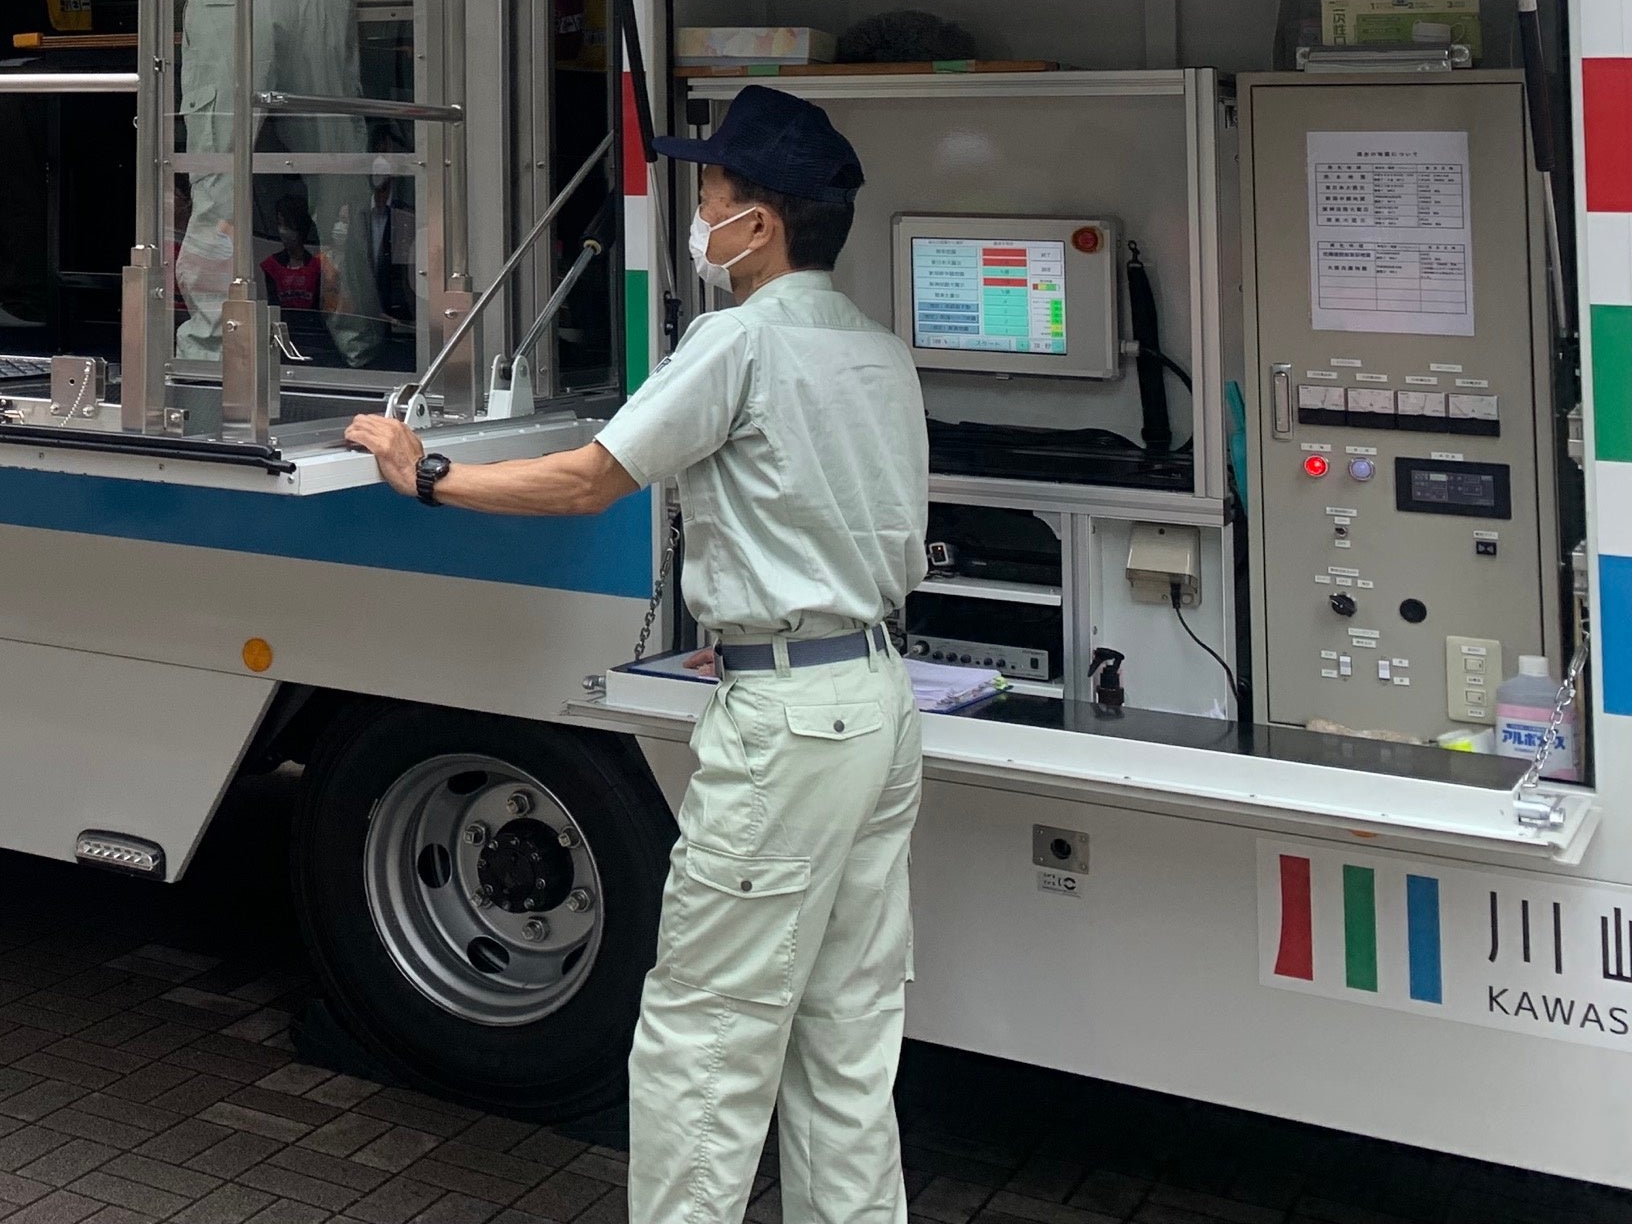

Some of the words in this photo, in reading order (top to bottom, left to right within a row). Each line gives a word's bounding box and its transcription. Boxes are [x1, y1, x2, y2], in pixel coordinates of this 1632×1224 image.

[1502, 729, 1566, 750] アルボナス
[1489, 985, 1629, 1035] KAWAS
